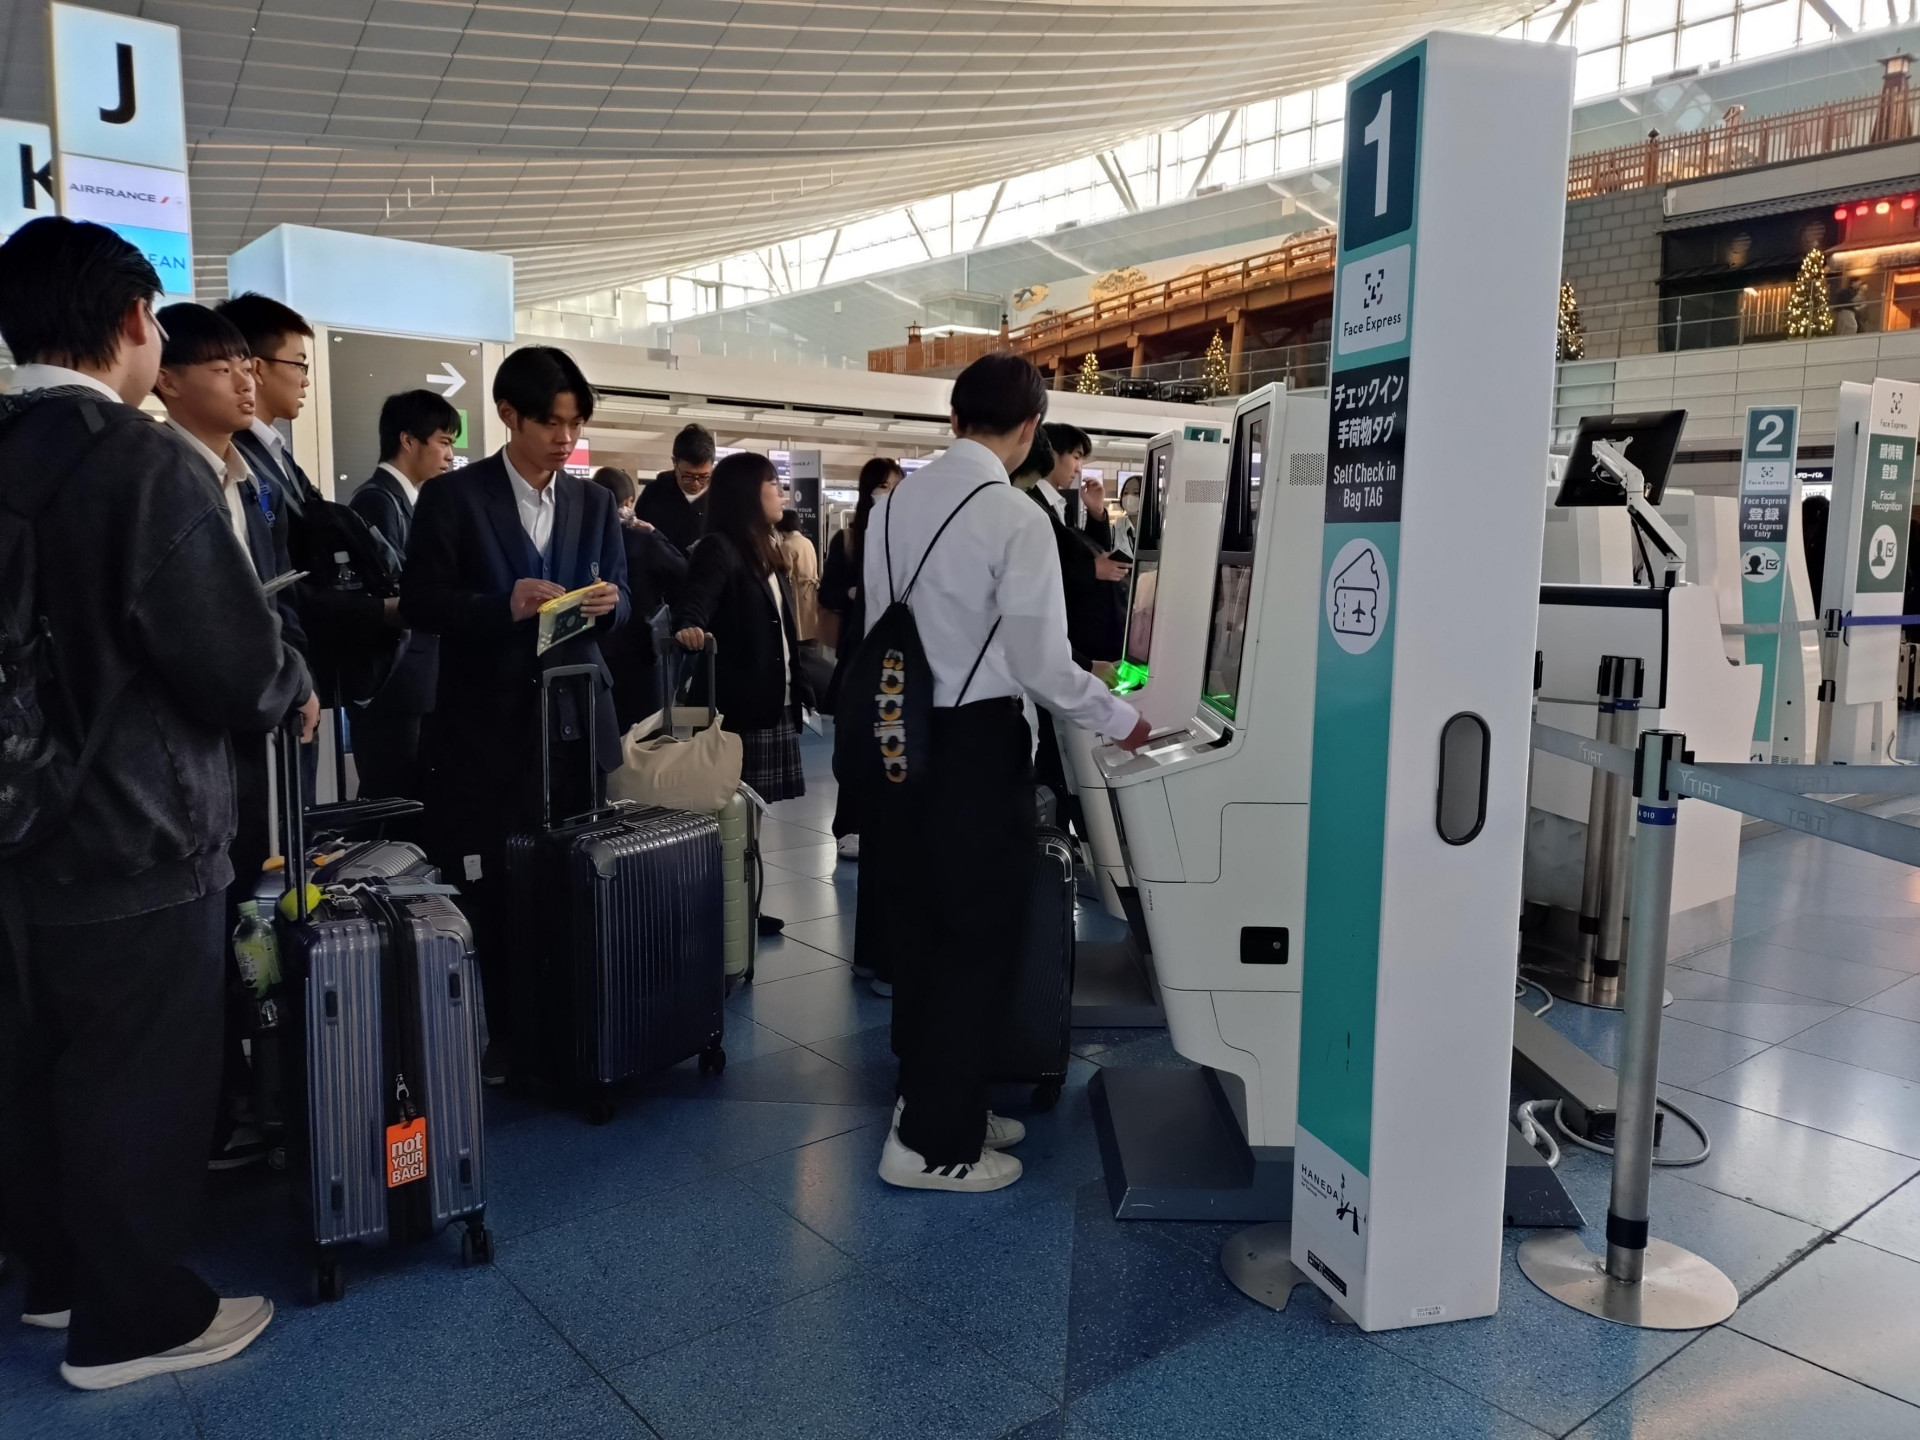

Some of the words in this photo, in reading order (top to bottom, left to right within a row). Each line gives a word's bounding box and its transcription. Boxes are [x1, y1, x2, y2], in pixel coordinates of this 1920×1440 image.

[98, 41, 136, 125] J
[1364, 89, 1393, 217] 1
[19, 142, 54, 210] K
[69, 183, 157, 203] AIRFRANCE
[147, 253, 186, 270] EAN
[1343, 321, 1364, 337] Face
[1365, 313, 1402, 333] Express
[1334, 374, 1404, 412] チェックイン
[1197, 431, 1205, 442] 1
[1337, 411, 1397, 449] 手荷物タグ
[1755, 414, 1785, 452] 2
[1879, 443, 1904, 461] 顔情報
[1333, 463, 1354, 485] Self
[1354, 460, 1385, 483] Check
[1386, 460, 1396, 481] in
[1881, 464, 1899, 480] 登録
[1343, 488, 1361, 512] Bag
[1364, 486, 1383, 507] TAG
[1744, 497, 1760, 505] Face
[1760, 497, 1787, 506] Express
[1871, 500, 1903, 512] Recognition
[1880, 490, 1897, 500] Facial
[1748, 507, 1780, 521] 登録
[1743, 522, 1758, 530] Face
[1758, 522, 1784, 532] Express
[1754, 530, 1771, 539] Entry
[873, 648, 908, 783] adidas
[1689, 778, 1722, 800] TIAT
[391, 1132, 423, 1158] not
[391, 1150, 423, 1169] YOUR
[391, 1162, 424, 1184] BAG!
[1301, 1163, 1339, 1201] HANEDA
